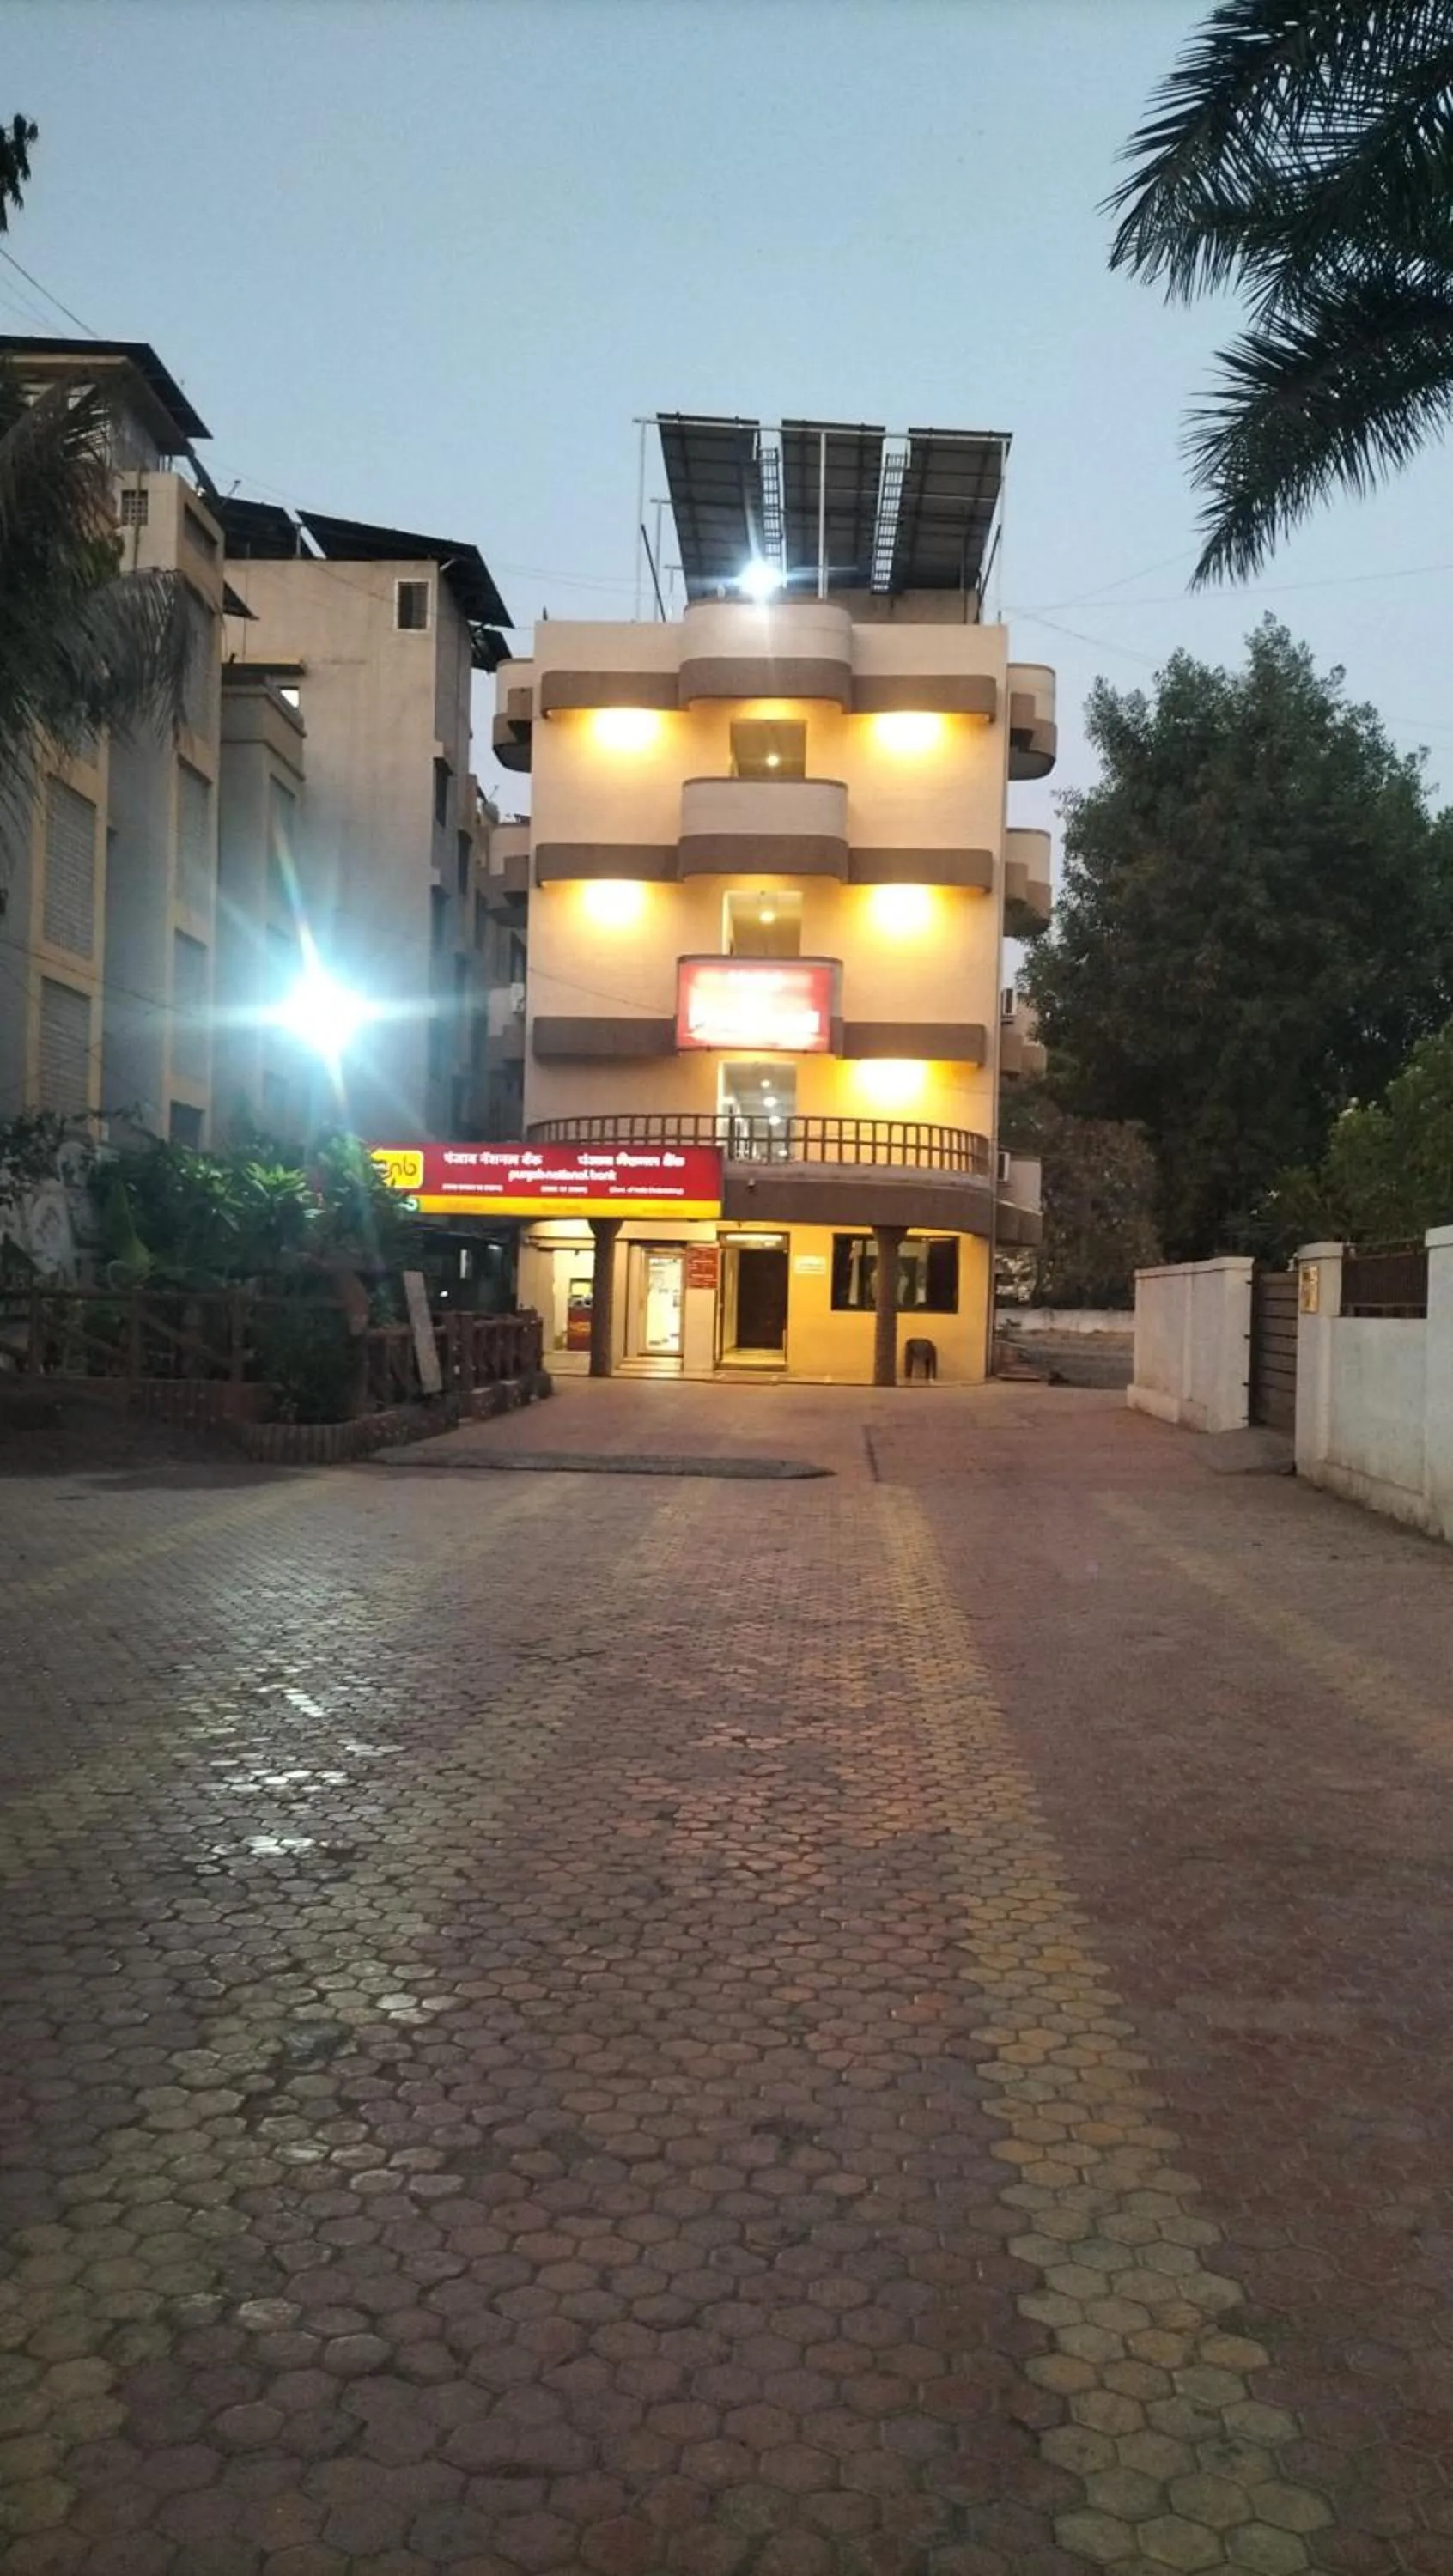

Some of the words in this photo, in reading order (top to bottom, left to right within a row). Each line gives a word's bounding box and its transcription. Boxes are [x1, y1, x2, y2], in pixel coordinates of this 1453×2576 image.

[508, 1168, 544, 1182] punjab
[545, 1169, 589, 1181] national
[590, 1169, 617, 1181] bank
